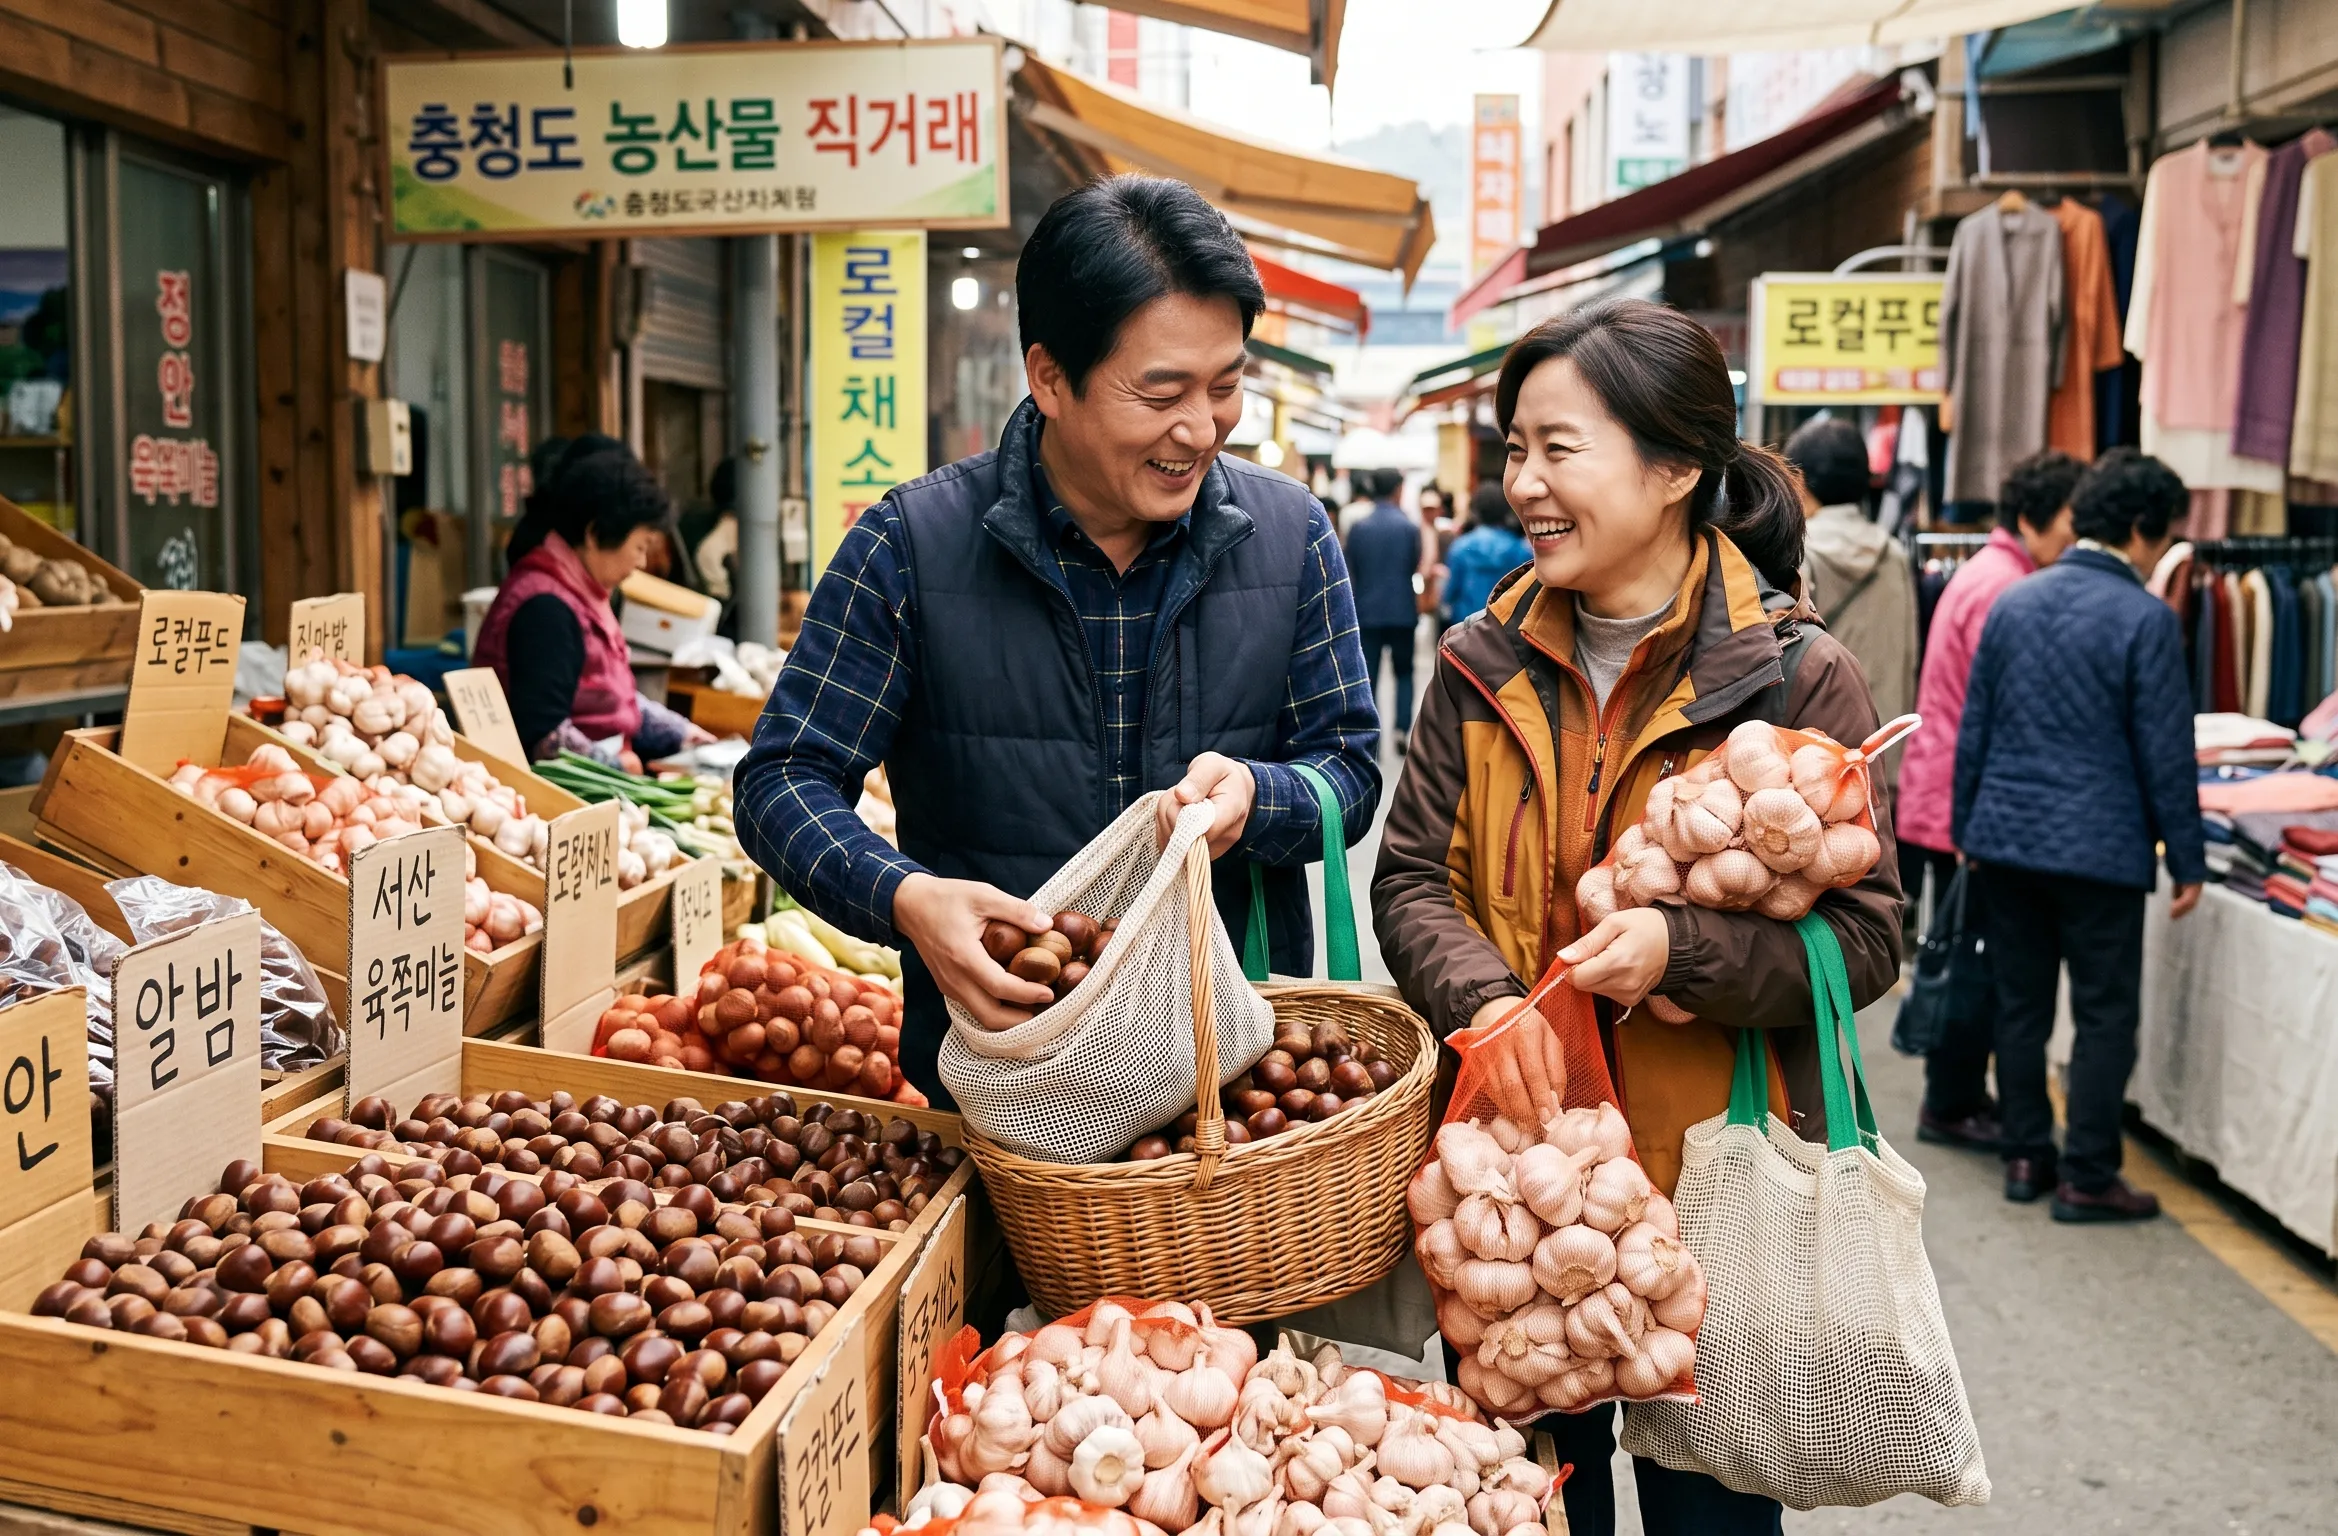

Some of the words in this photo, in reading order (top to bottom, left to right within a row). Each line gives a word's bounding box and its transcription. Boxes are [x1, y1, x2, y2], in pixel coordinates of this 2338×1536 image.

[409, 104, 582, 180] 충청도
[604, 97, 780, 175] 농산물
[806, 91, 980, 167] 직거래
[840, 247, 898, 360] 로컬
[840, 375, 898, 487] 채소
[148, 616, 230, 674] 로컬푸드
[373, 849, 435, 931] 서산
[136, 948, 243, 1090] 알밤
[4, 1035, 62, 1171] 안
